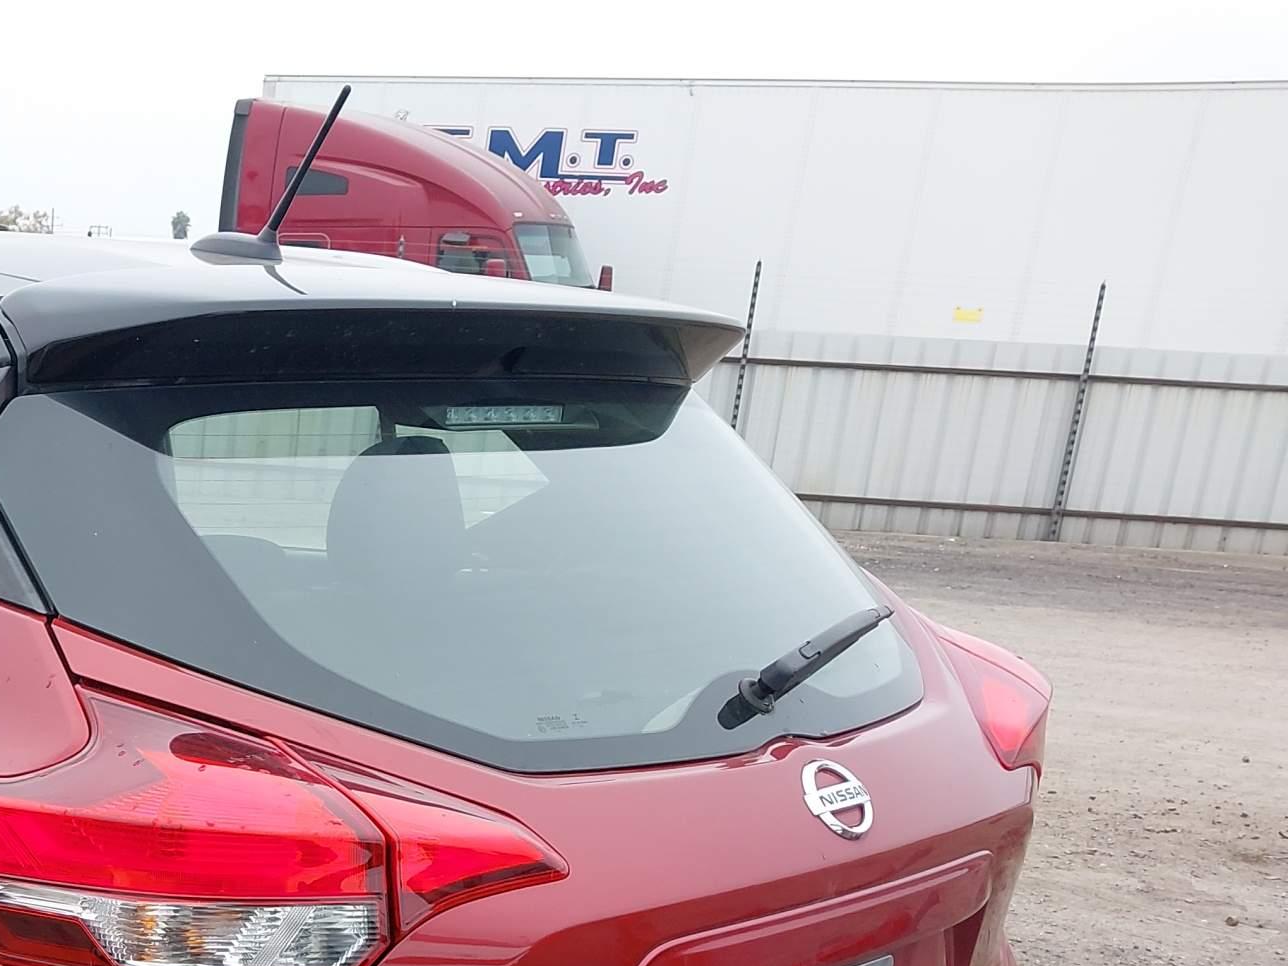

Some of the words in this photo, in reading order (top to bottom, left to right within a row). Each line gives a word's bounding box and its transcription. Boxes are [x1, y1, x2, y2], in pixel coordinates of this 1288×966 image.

[431, 127, 635, 179] M.T.
[625, 171, 668, 194] Inc
[819, 784, 869, 807] NISSAN
